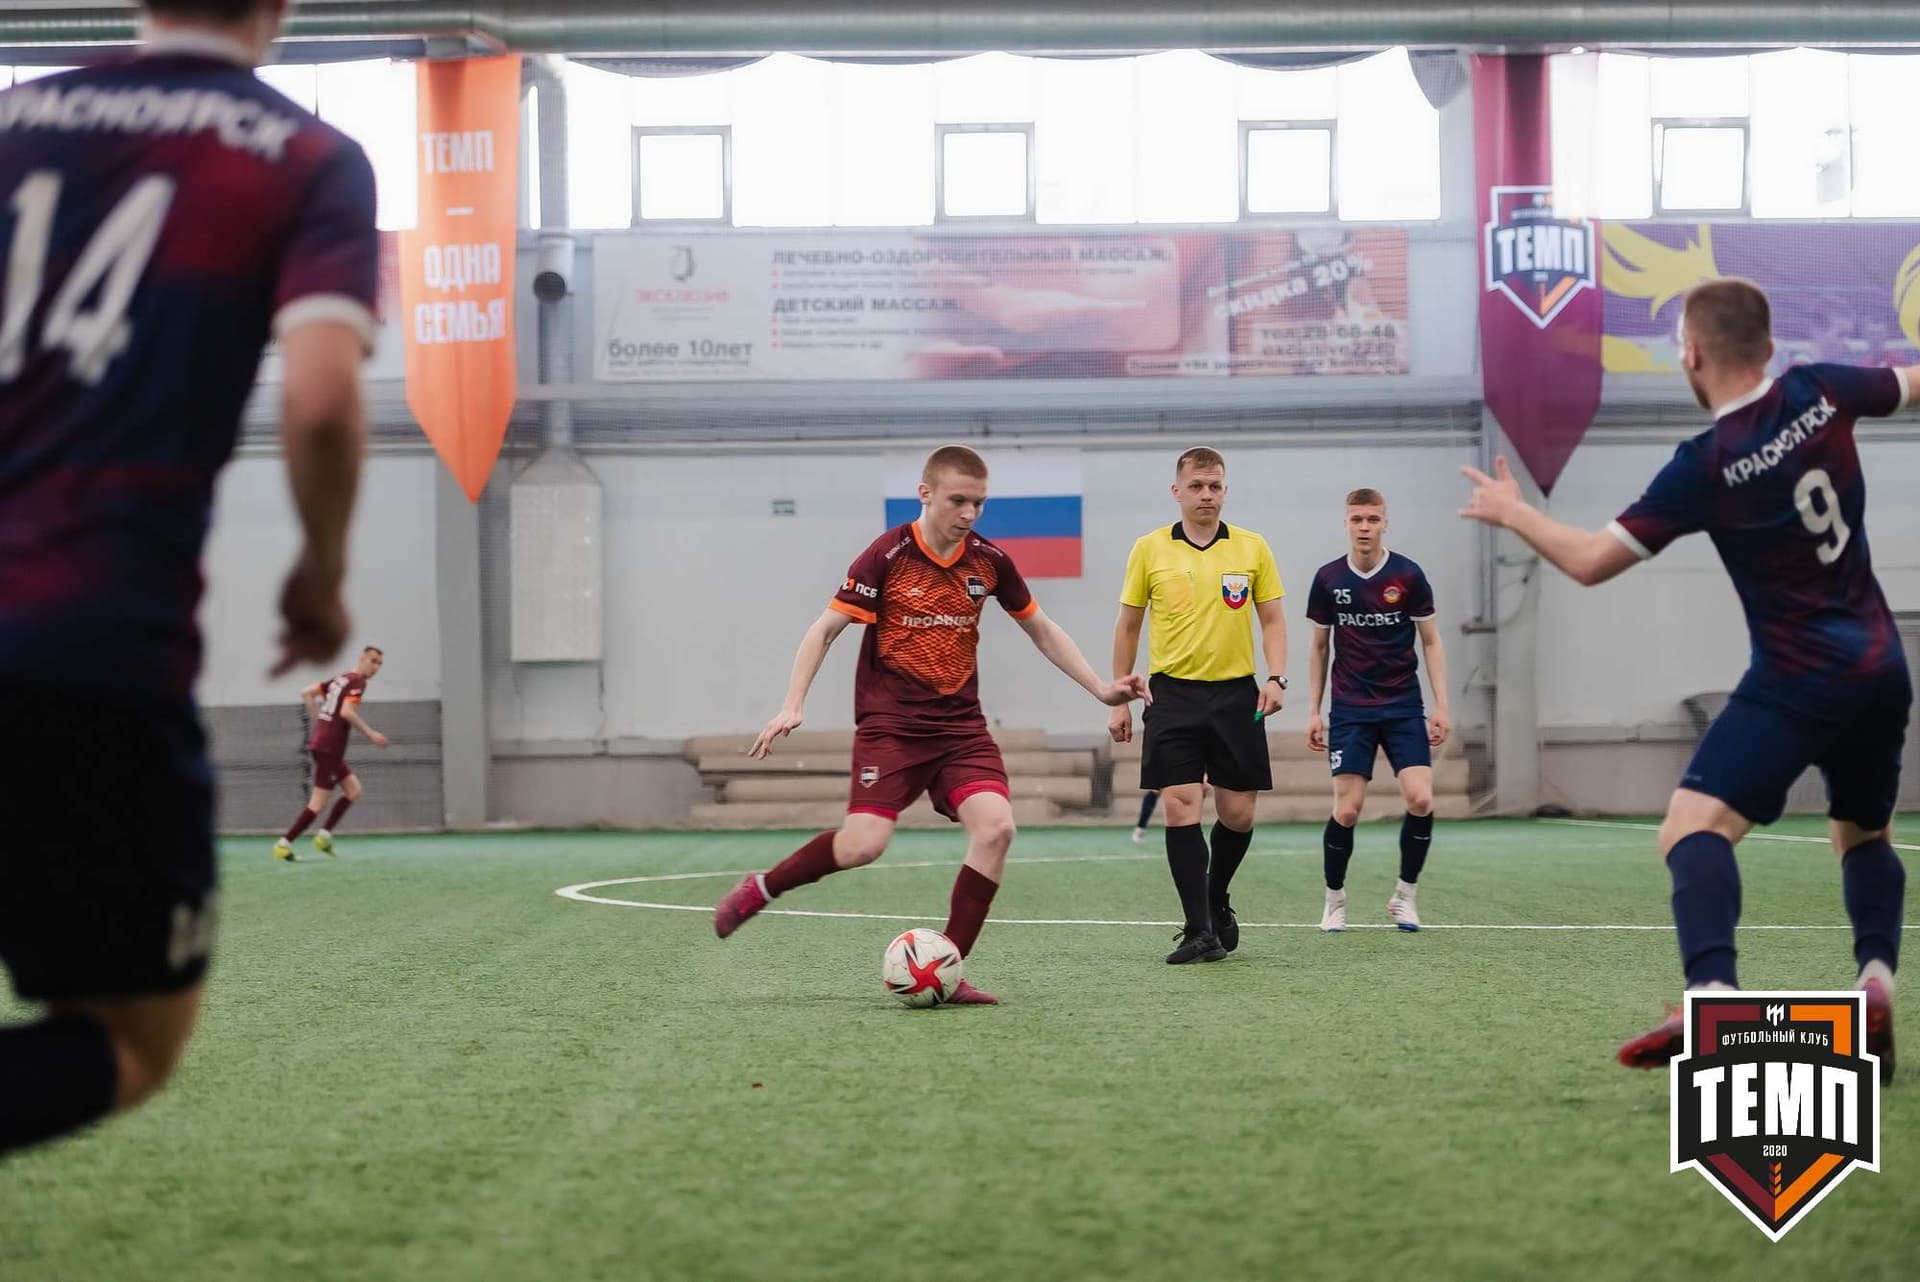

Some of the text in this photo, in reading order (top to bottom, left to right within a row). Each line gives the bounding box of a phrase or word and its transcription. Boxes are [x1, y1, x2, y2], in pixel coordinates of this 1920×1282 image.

[422, 130, 493, 174] ТЕМП
[424, 243, 500, 291] ОДНА
[1496, 225, 1584, 274] ТЕМП
[0, 170, 174, 383] 14
[415, 298, 506, 344] СЕМЬЯ
[773, 294, 865, 314] ДЕТСКИЙ
[608, 339, 679, 358] более
[1793, 468, 1850, 565] 9
[856, 584, 878, 598] ПСБ
[1333, 588, 1352, 604] 25
[1338, 611, 1402, 627] РАССВЕТ
